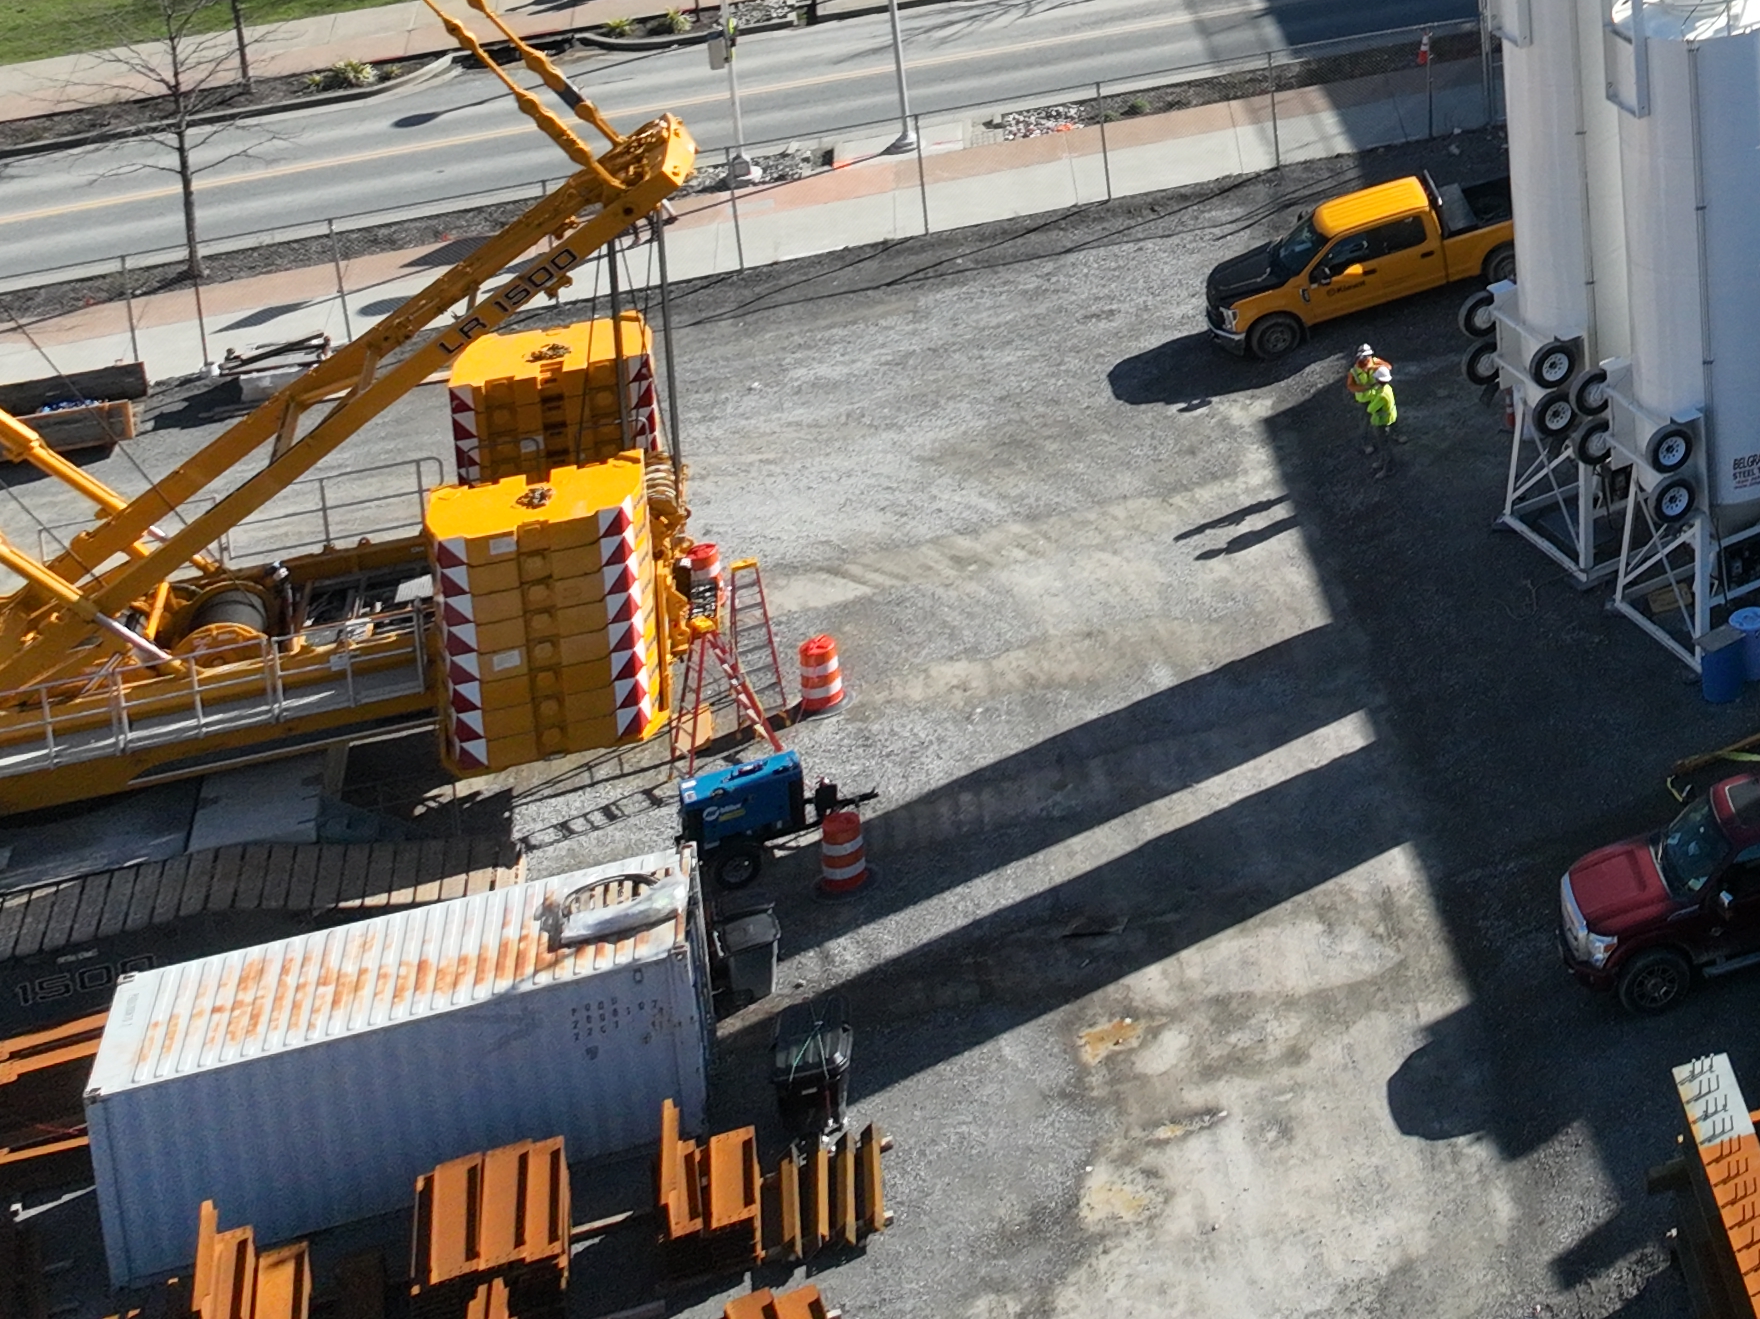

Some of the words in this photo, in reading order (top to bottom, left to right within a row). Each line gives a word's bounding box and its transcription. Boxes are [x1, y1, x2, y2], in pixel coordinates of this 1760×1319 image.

[439, 317, 488, 354] LR
[493, 248, 578, 312] 1500
[1732, 466, 1756, 481] STEEL
